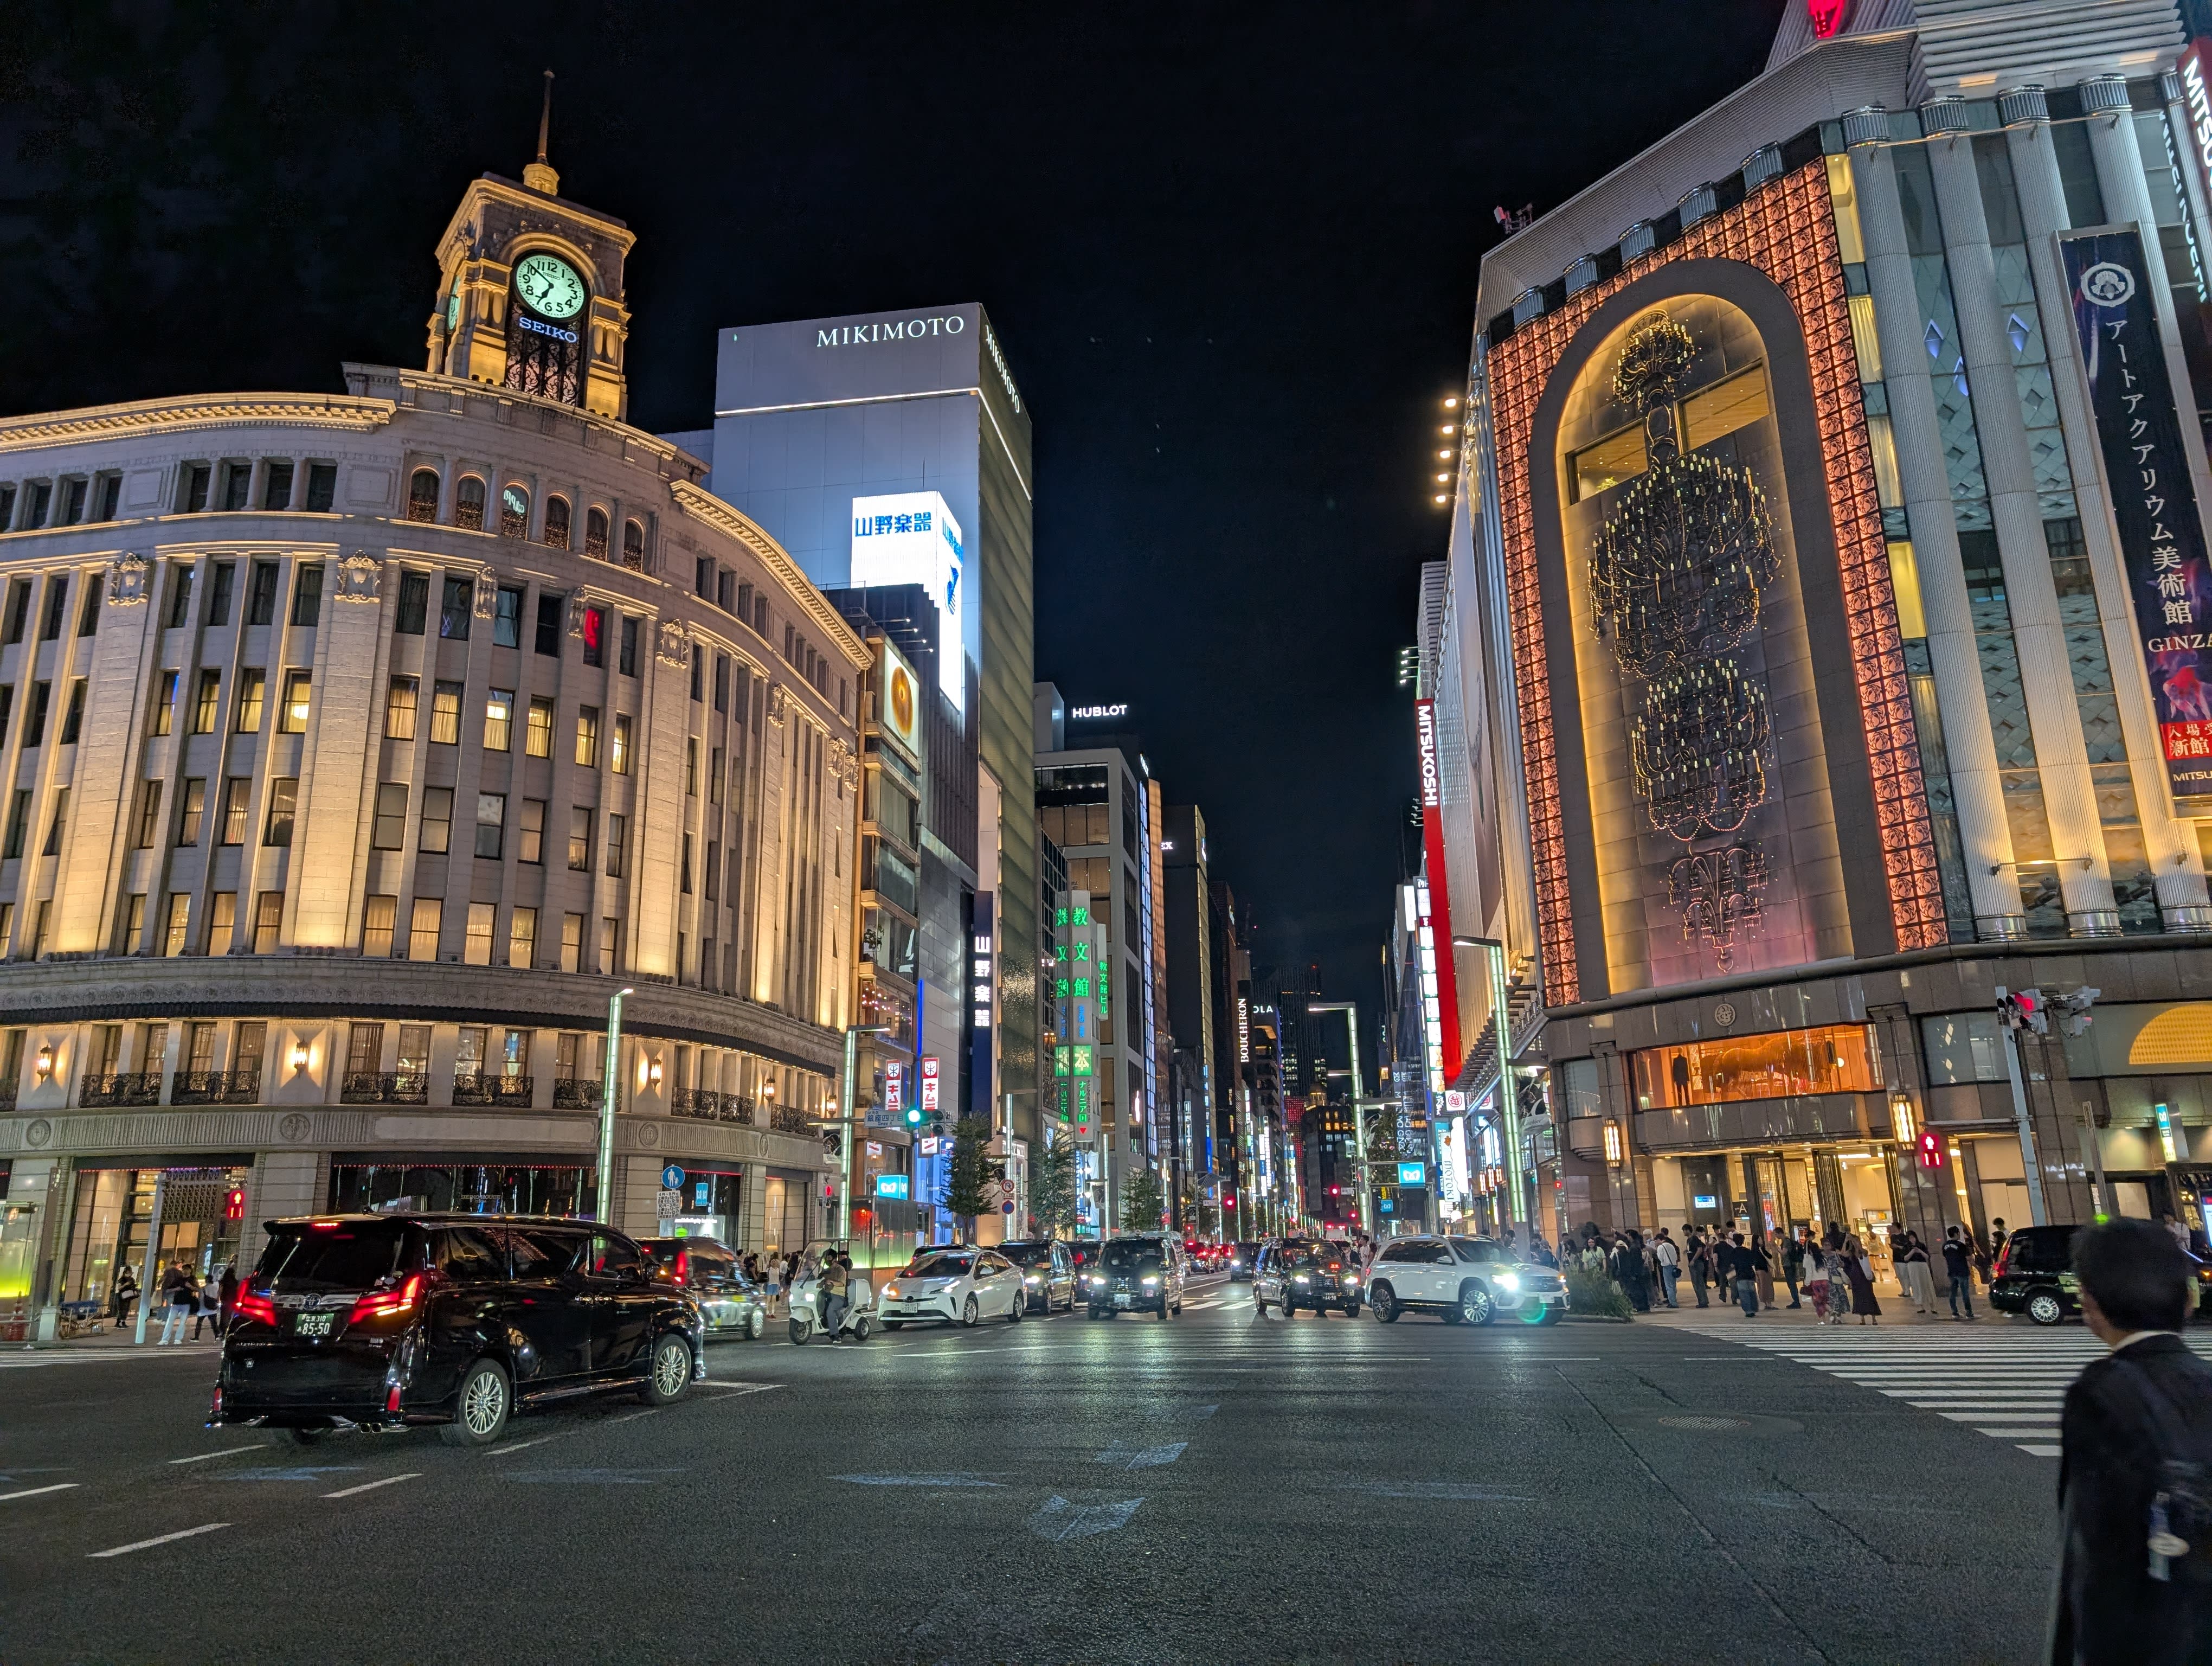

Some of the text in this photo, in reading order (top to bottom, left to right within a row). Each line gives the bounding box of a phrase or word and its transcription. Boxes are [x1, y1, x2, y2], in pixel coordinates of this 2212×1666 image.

[537, 261, 544, 271] 11
[548, 261, 557, 273] 12
[523, 274, 530, 284] 9
[543, 272, 561, 280] SEIKO
[562, 269, 564, 278] 1
[525, 285, 533, 296] 8
[568, 279, 575, 289] 2
[570, 290, 577, 299] 3
[544, 302, 552, 311] 6
[556, 303, 563, 312] 5
[565, 299, 573, 308] 4
[519, 317, 577, 343] SEIKO
[817, 316, 964, 347] MIKIMOTO
[986, 324, 1020, 413] MIKIMOTO
[2105, 319, 2192, 625] アートアクアリウム美術館
[855, 511, 932, 537] 山野楽器
[1072, 704, 1127, 718] HUBLOT
[2170, 737, 2210, 757] 新館
[1418, 706, 1438, 807] MITSUKOSHI
[1073, 907, 1089, 998] 教文館
[975, 935, 990, 1027] 山野楽器
[1099, 962, 1108, 1015] 教文館ビル
[1253, 1005, 1273, 1014] OLA
[1237, 998, 1249, 1063] BOUCHERON
[1074, 1050, 1090, 1071] 本
[1078, 1081, 1088, 1122] ナルニア国
[302, 1323, 330, 1335] 85-50
